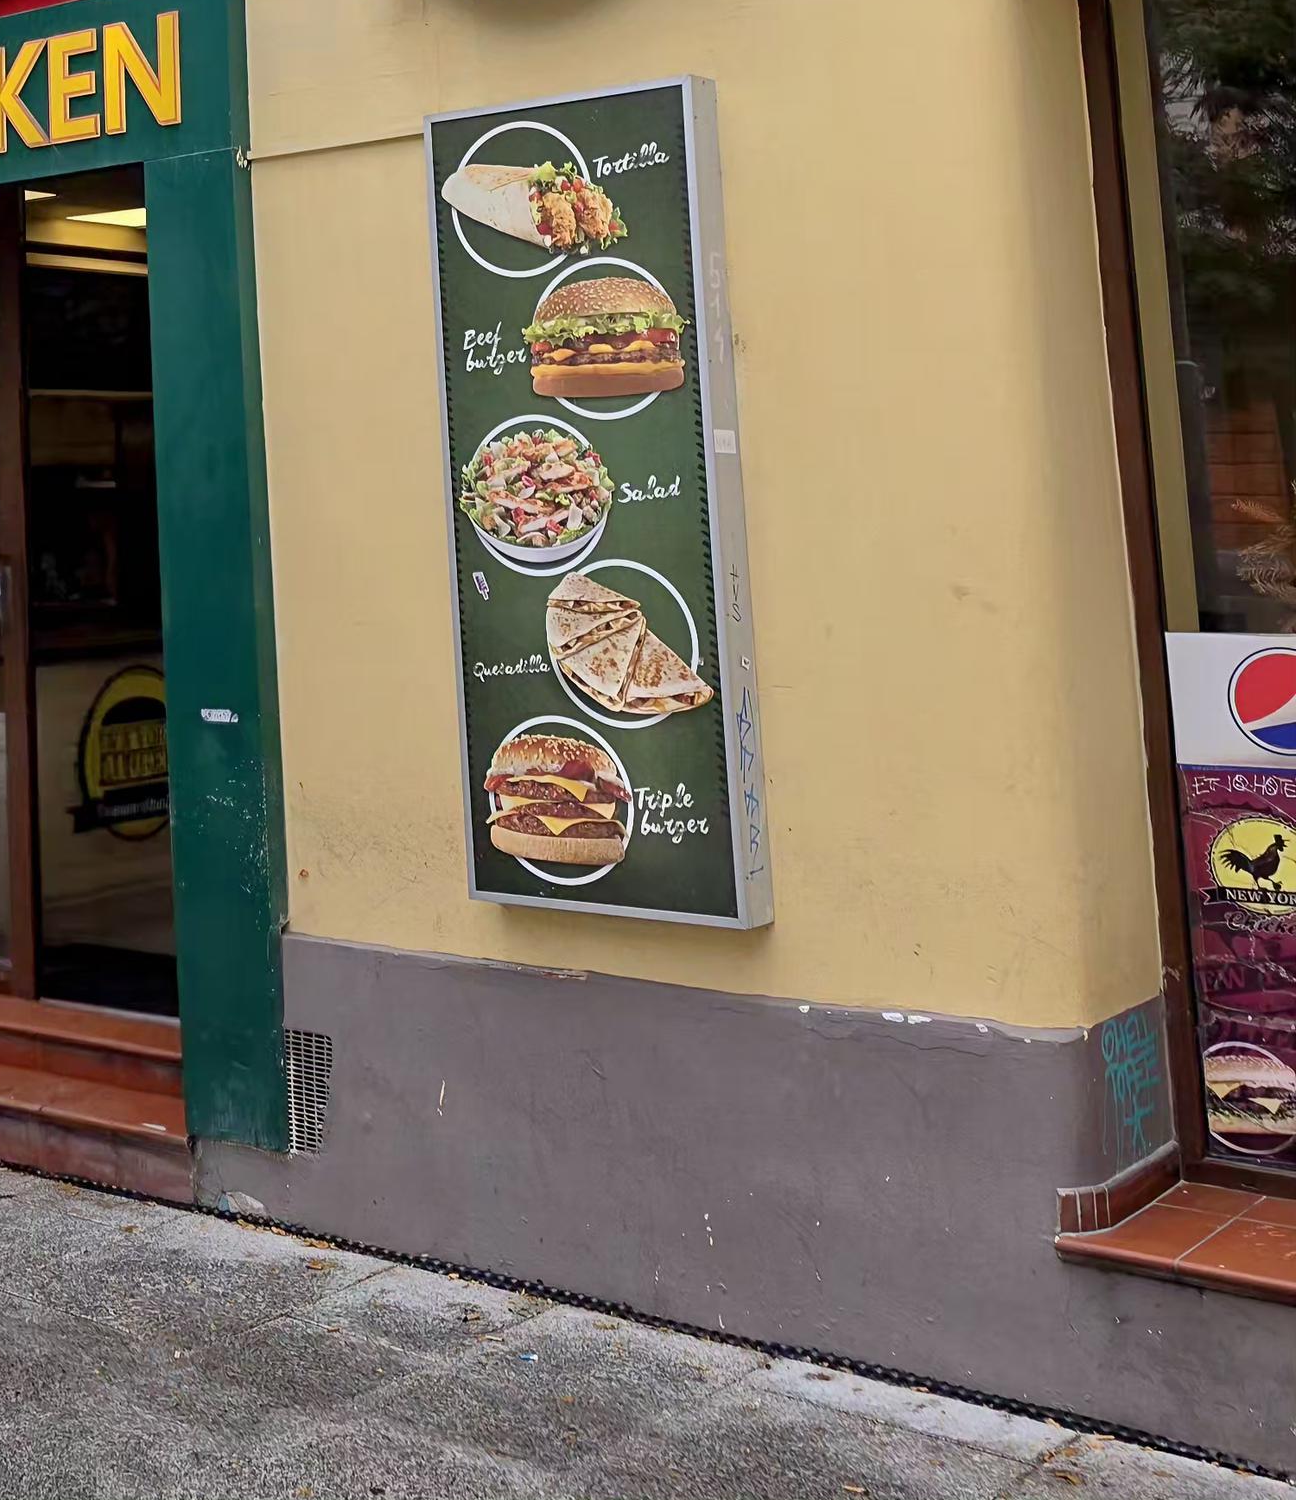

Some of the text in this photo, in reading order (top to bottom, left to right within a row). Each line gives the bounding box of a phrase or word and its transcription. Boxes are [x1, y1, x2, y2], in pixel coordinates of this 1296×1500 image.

[592, 141, 671, 179] Tortilla
[463, 321, 503, 351] Beef
[465, 346, 528, 377] burger
[617, 474, 682, 504] Salad
[473, 653, 552, 684] Quesadilla
[633, 782, 696, 811] Triple
[639, 811, 710, 845] burger
[1225, 888, 1263, 903] NEW
